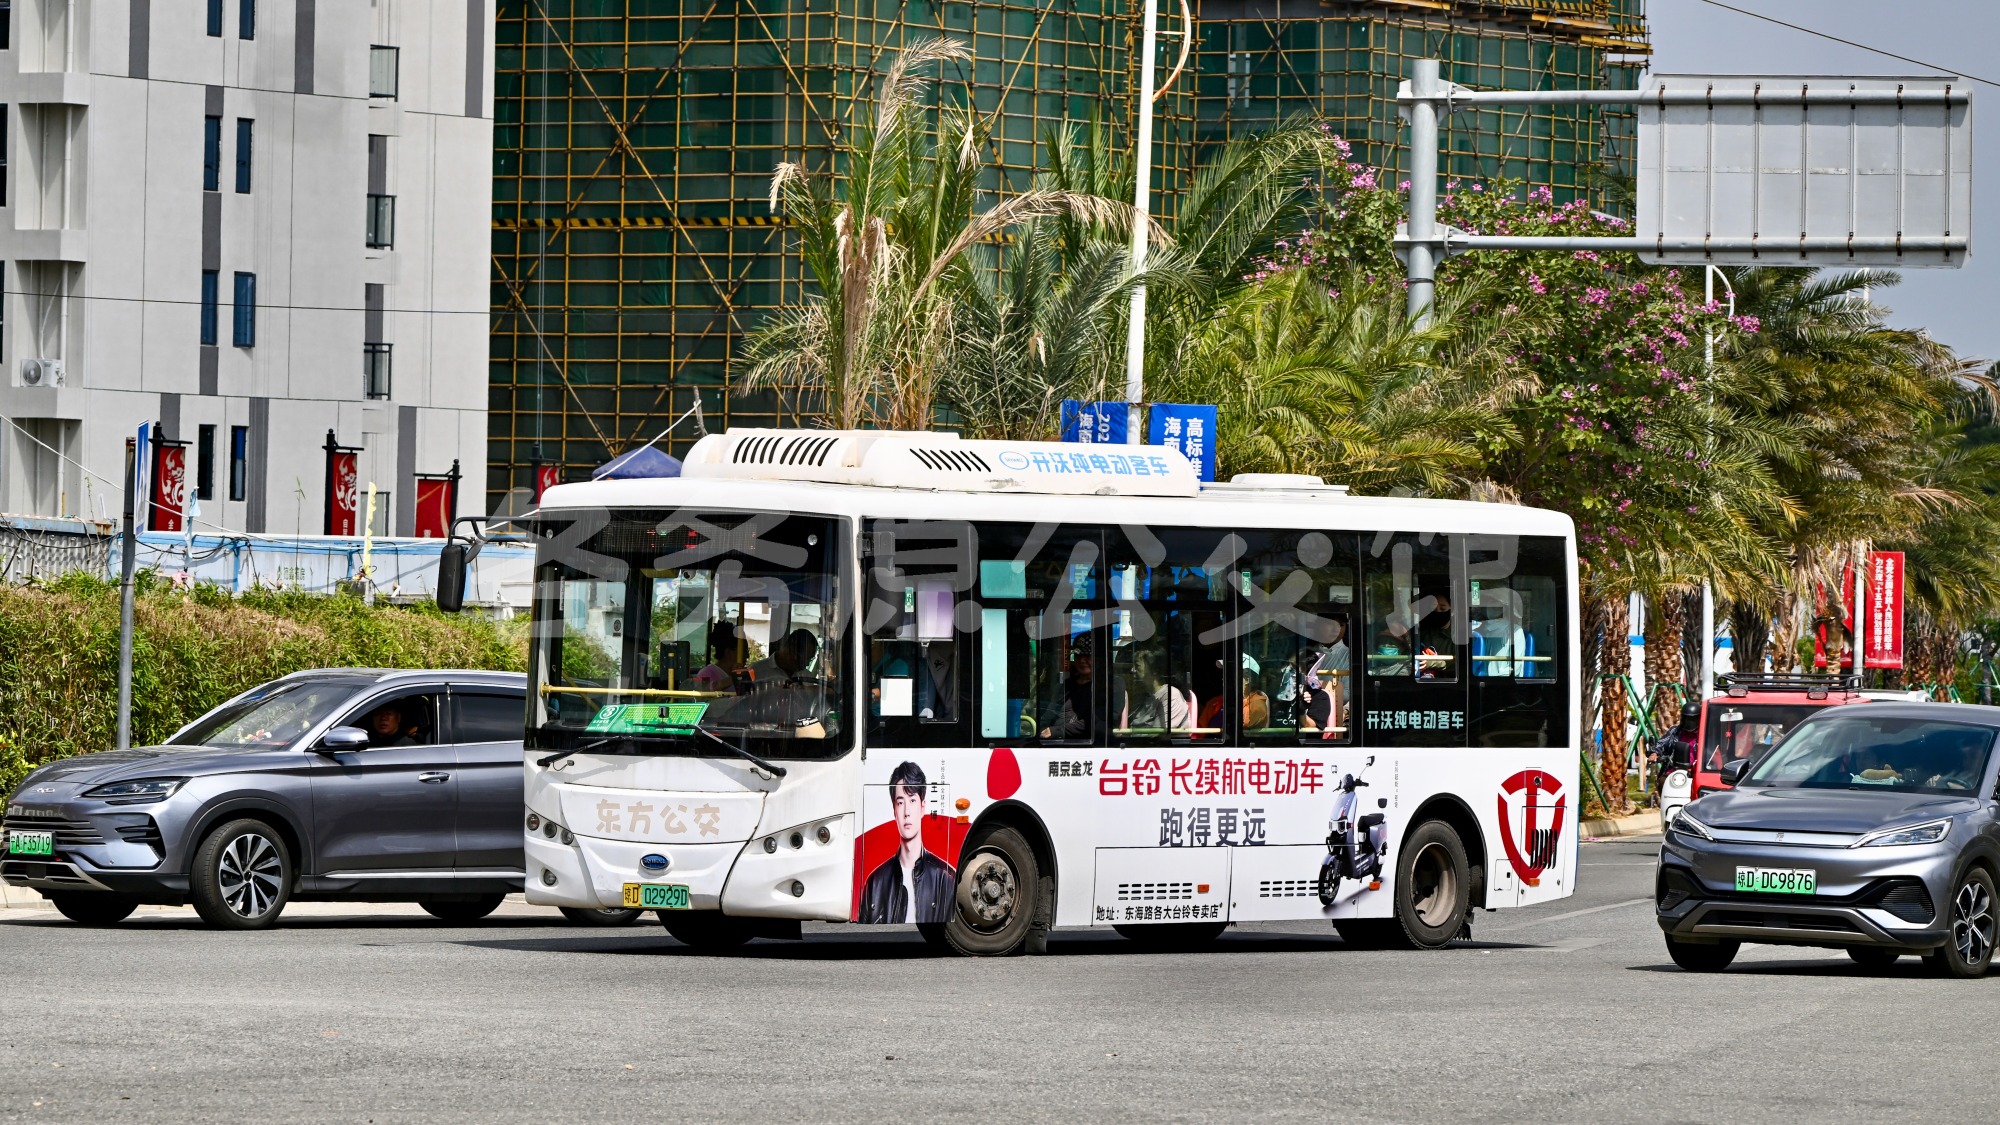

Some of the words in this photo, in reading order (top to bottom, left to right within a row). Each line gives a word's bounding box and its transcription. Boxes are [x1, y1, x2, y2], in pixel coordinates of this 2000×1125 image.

[1030, 451, 1170, 476] 开沃纯电动客车
[1366, 710, 1464, 730] 开沃纯电动客车
[1048, 760, 1093, 777] 南京金龙
[1099, 758, 1161, 796] 台铃
[1168, 757, 1324, 795] 长续航电动车
[596, 799, 720, 837] 东方公交
[1159, 807, 1267, 847] 跑得更远
